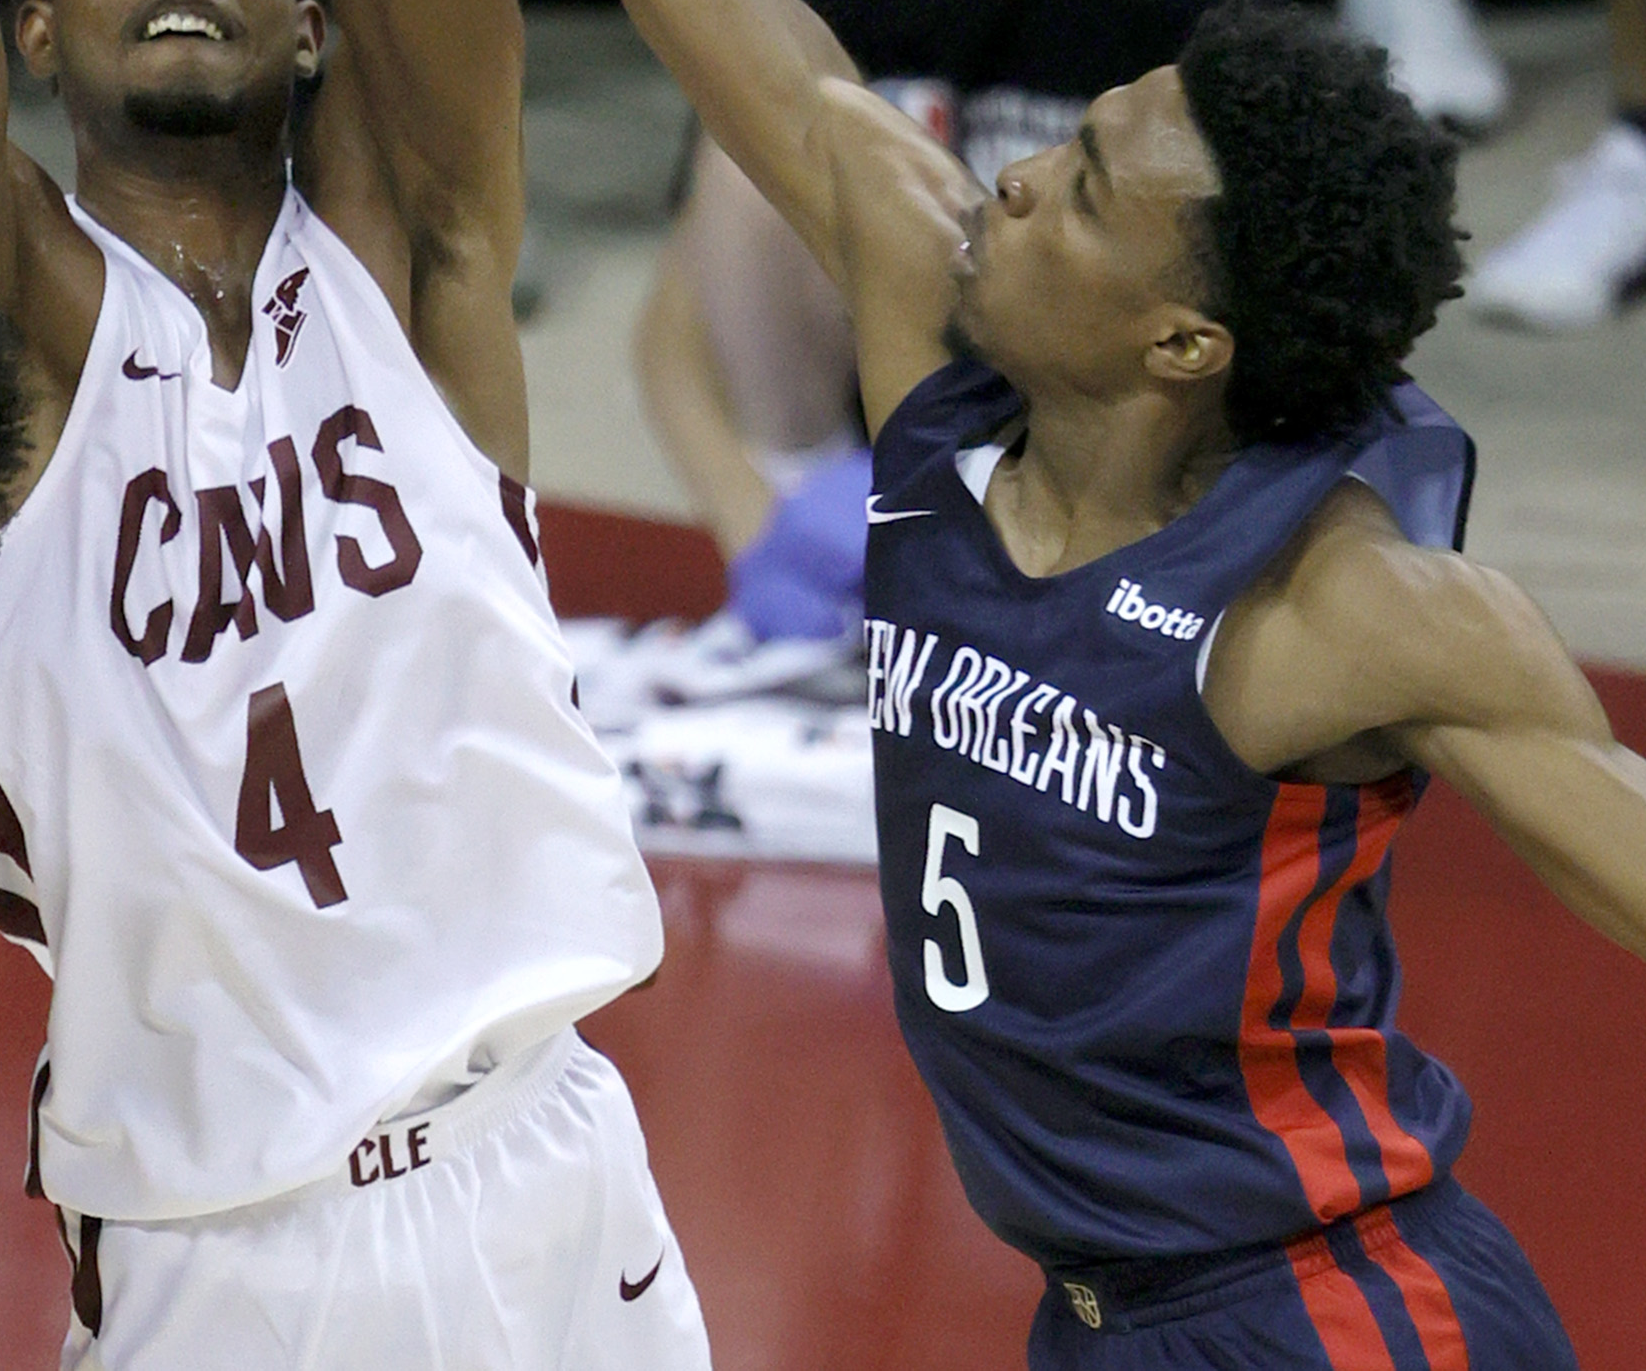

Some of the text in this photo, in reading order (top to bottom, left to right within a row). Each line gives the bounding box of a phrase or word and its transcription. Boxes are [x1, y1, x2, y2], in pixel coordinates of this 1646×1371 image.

[110, 405, 422, 667] CAVS
[1106, 579, 1204, 639] ibotta
[235, 683, 348, 908] 4
[931, 646, 1166, 839] ORLEANS
[922, 804, 989, 1011] 5
[349, 1123, 430, 1186] CLE
